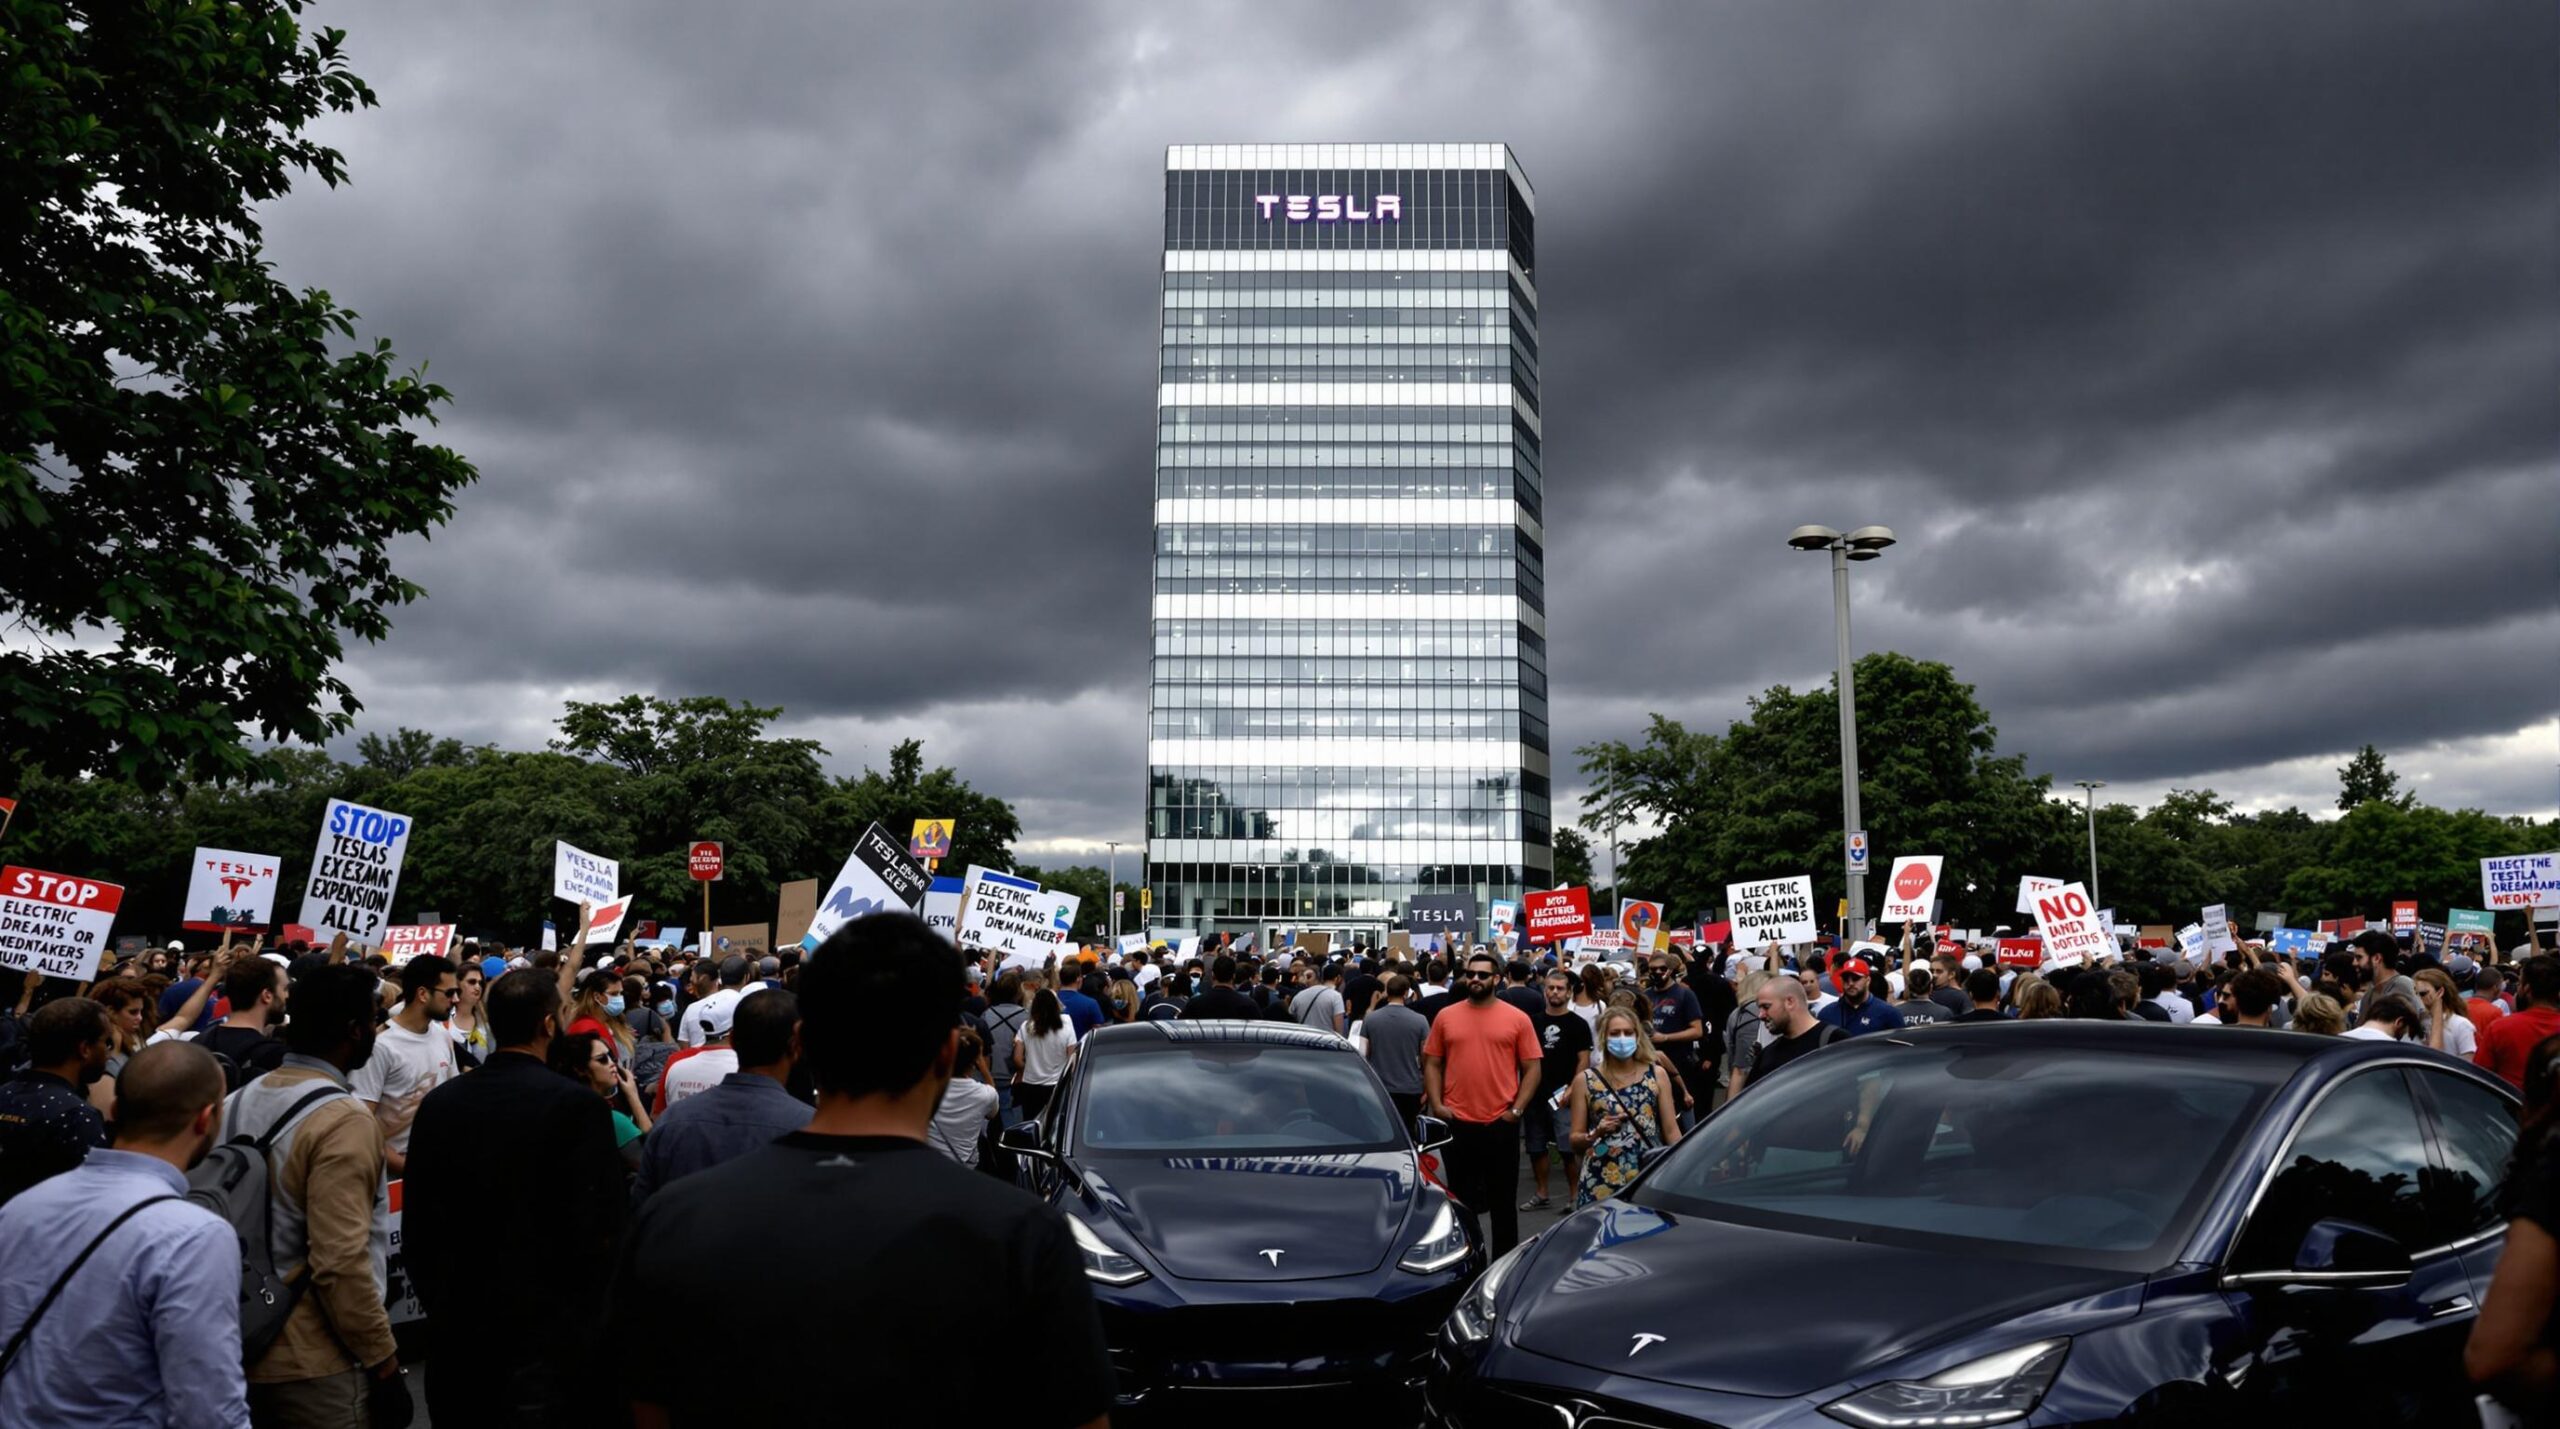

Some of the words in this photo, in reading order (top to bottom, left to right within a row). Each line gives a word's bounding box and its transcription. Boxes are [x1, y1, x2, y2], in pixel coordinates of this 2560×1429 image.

[1256, 195, 1401, 220] TESLA
[206, 861, 273, 878] TESLA
[12, 872, 99, 905] STOP
[976, 882, 1032, 906] ELECTRIC
[3, 900, 78, 925] ELECTRIC
[1412, 909, 1464, 922] TESLA
[1734, 896, 1806, 915] DREAMNS
[1888, 905, 1924, 915] TESLA
[2038, 892, 2087, 923] NO
[1, 917, 65, 939] DREAMS
[73, 930, 94, 944] OR
[1759, 928, 1786, 942] ALL
